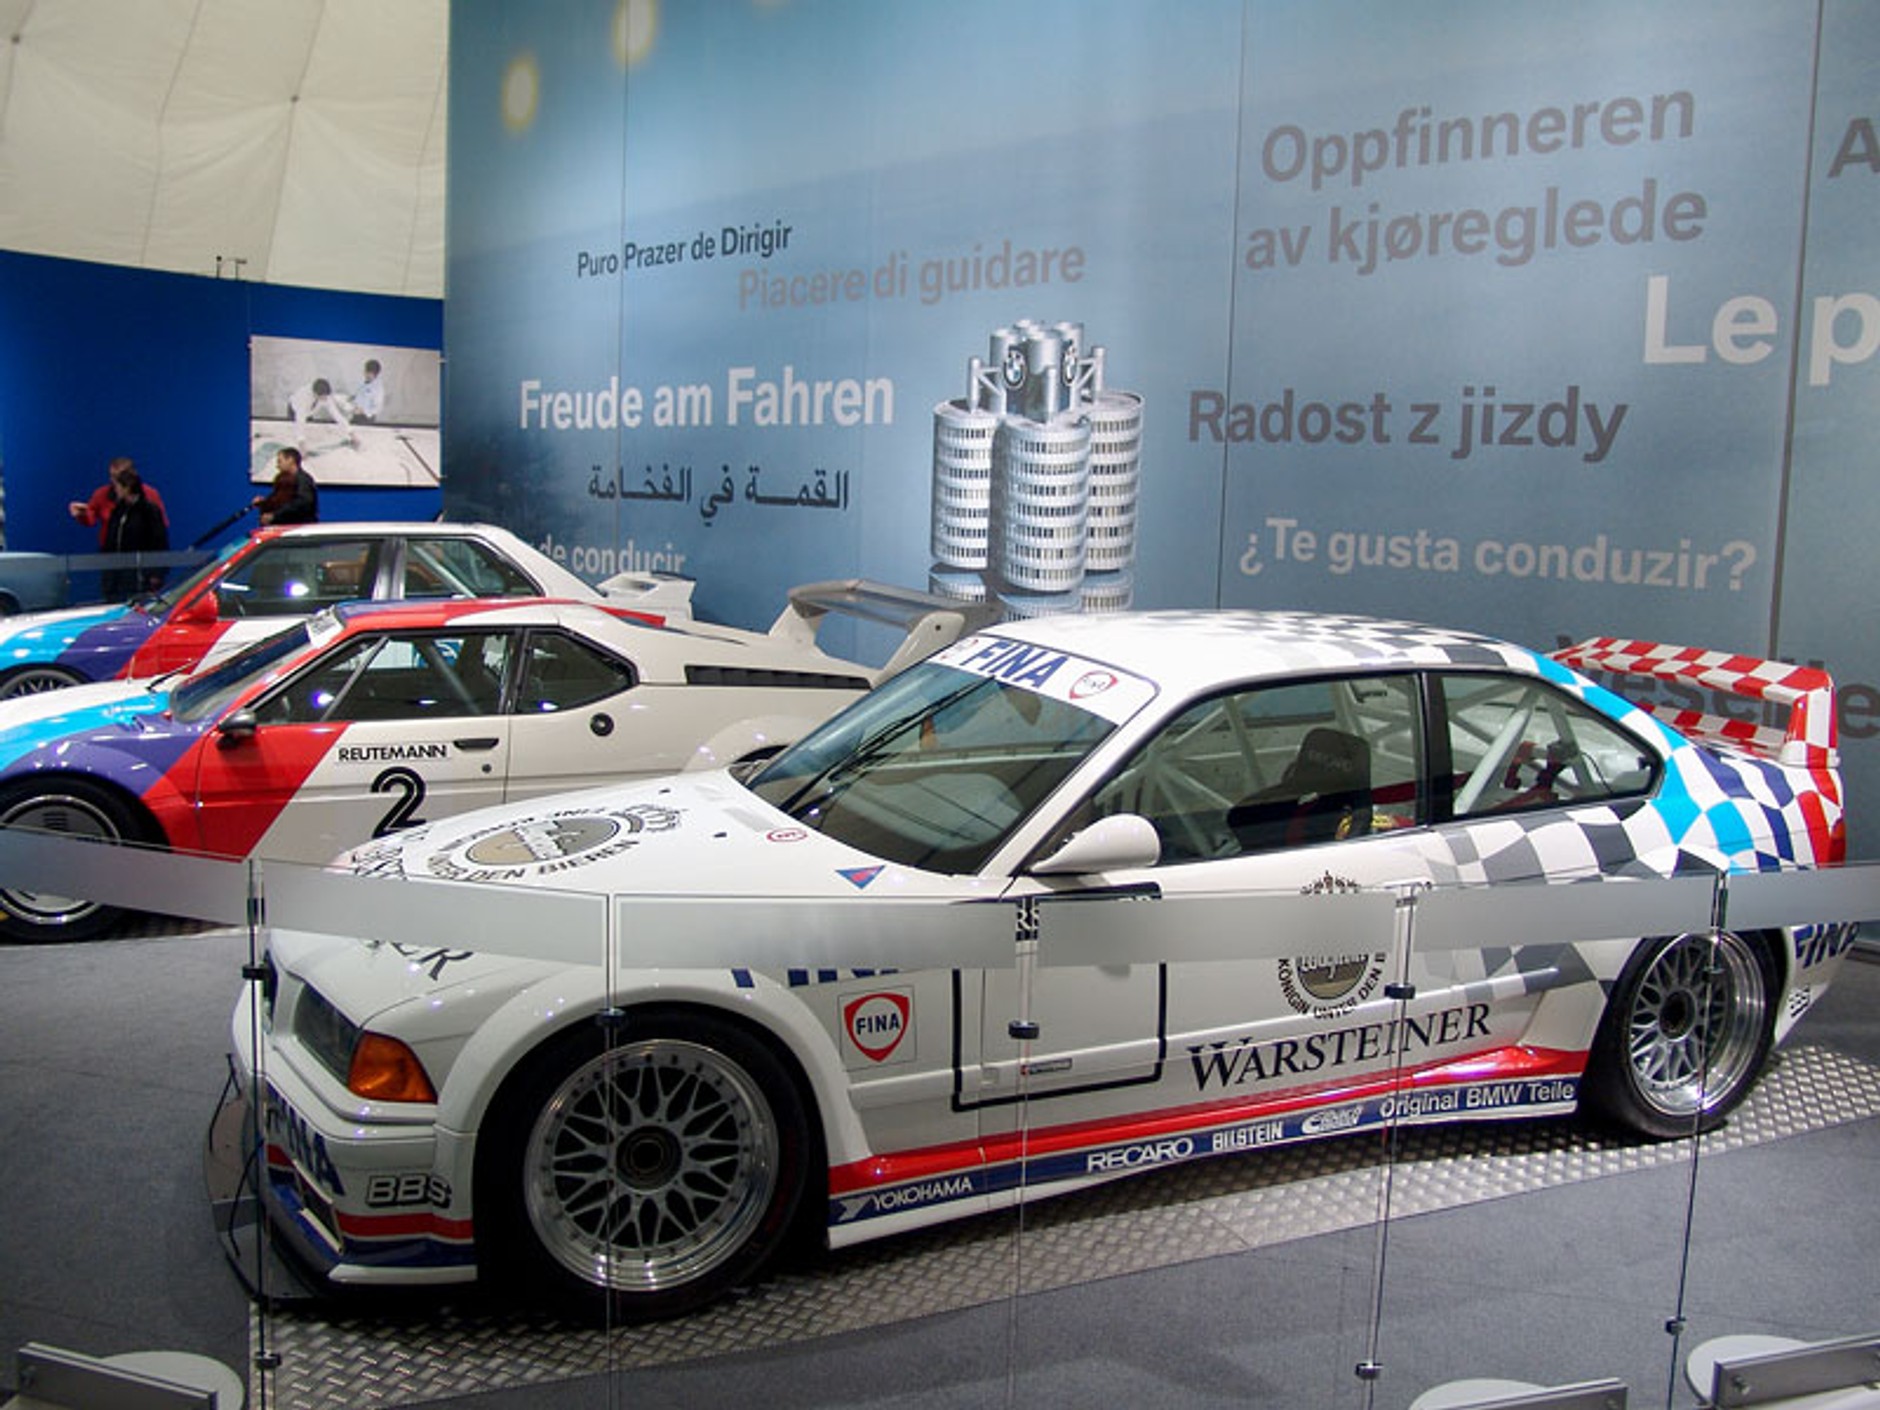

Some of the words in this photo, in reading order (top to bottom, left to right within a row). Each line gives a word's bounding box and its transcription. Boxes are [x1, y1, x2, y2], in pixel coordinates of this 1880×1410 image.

[1261, 89, 1694, 190] Oppfinneren
[577, 252, 618, 278] Puro
[624, 241, 687, 270] Prazer
[691, 232, 716, 260] de
[721, 219, 793, 259] Dirigir
[1245, 217, 1311, 270] av
[1328, 178, 1707, 275] kjøreglede
[738, 266, 866, 311] Piacere
[873, 250, 908, 300] di
[918, 238, 1086, 306] guidare
[1643, 275, 1778, 364] Le
[520, 376, 643, 430] Freude
[653, 383, 712, 427] am
[727, 365, 894, 428] Fahren
[1187, 388, 1391, 444] Radost
[1409, 404, 1439, 443] z
[1451, 385, 1630, 463] jizdy
[1239, 517, 1315, 577] ¿Te
[1328, 525, 1459, 573] gusta
[1475, 534, 1757, 592] conduzir?
[959, 639, 1071, 689] FINA
[338, 744, 447, 761] REUTEMANN
[370, 766, 427, 839] 2
[856, 1013, 901, 1035] FINA
[1186, 1001, 1493, 1092] WARSTEINER
[1379, 1088, 1459, 1120] Original
[1465, 1084, 1524, 1107] BMW
[1527, 1078, 1575, 1103] Teile
[1087, 1136, 1194, 1173] RECARO
[1212, 1120, 1284, 1154] BILSTEIN
[367, 1174, 453, 1209] BBS
[872, 1176, 974, 1212] YOKOHAMA
